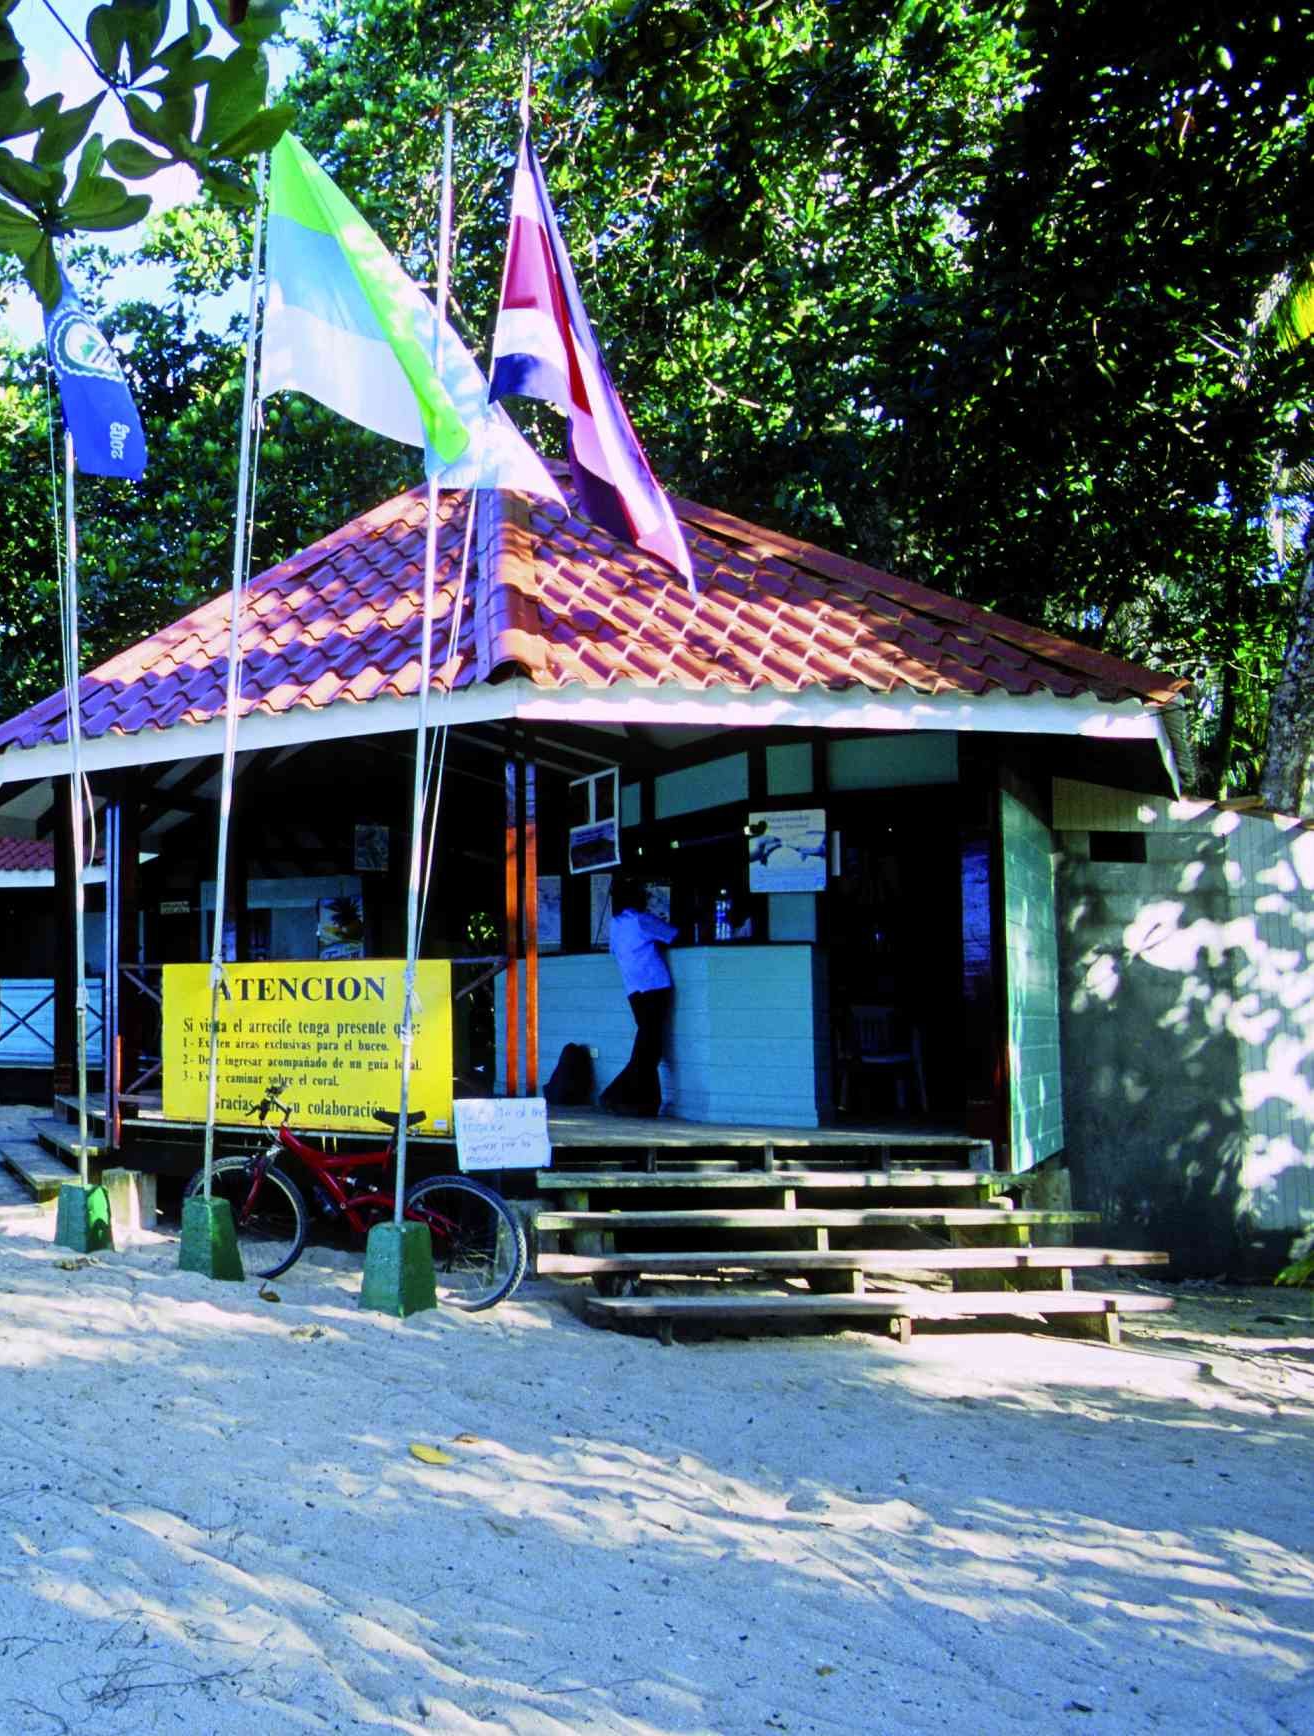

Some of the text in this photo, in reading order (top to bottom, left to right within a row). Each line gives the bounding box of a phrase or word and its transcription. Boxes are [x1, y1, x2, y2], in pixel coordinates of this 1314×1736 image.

[212, 977, 386, 1003] ATENCION
[182, 1018, 194, 1033] Si
[233, 1018, 242, 1033] el
[249, 1018, 292, 1034] arrecife
[299, 1020, 330, 1037] tenga
[337, 1021, 386, 1038] presente
[393, 1022, 421, 1038] qe:
[265, 1039, 311, 1050] exclusivas
[317, 1041, 339, 1053] para
[344, 1040, 352, 1051] el
[332, 1057, 344, 1068] de
[349, 1060, 362, 1069] un
[394, 1057, 422, 1070] loal.
[225, 1072, 263, 1085] caminar
[299, 1074, 307, 1086] el
